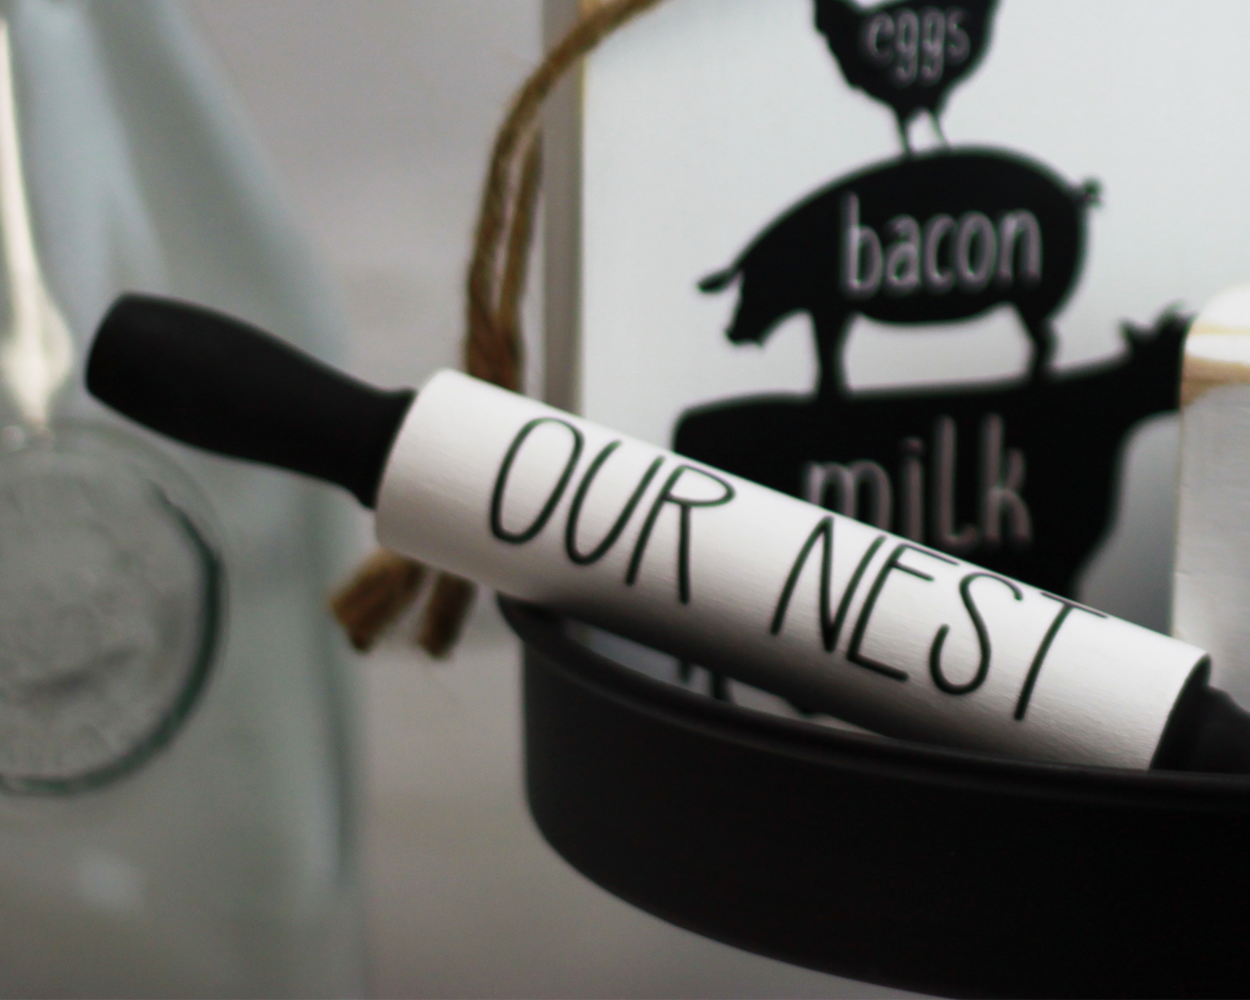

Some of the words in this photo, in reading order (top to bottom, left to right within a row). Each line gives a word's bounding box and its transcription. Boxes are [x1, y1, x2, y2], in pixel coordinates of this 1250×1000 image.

[867, 8, 969, 82] eggs
[845, 194, 1042, 293] bacon
[807, 413, 1033, 546] milk
[489, 417, 735, 604] OUR
[771, 516, 1108, 721] NEST
